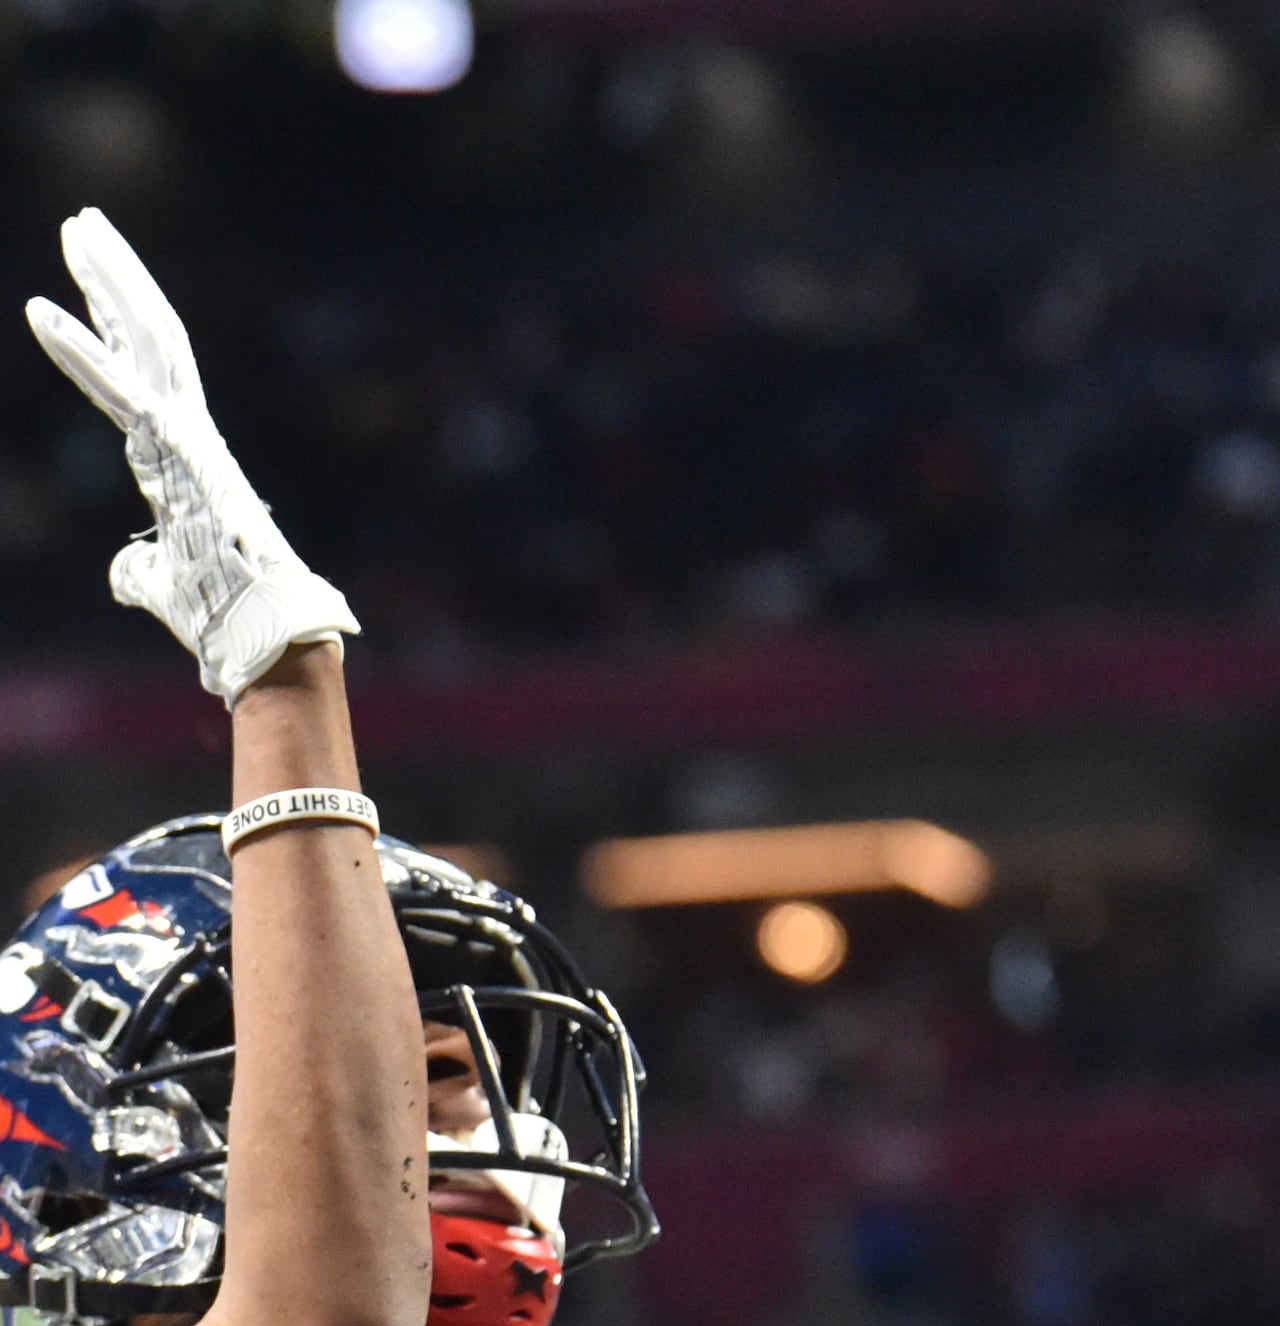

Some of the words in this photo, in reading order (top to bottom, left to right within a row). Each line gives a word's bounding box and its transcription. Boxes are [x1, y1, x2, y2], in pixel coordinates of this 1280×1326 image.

[288, 794, 340, 812] SHIT
[346, 797, 372, 818] GET
[232, 799, 281, 833] DONE
